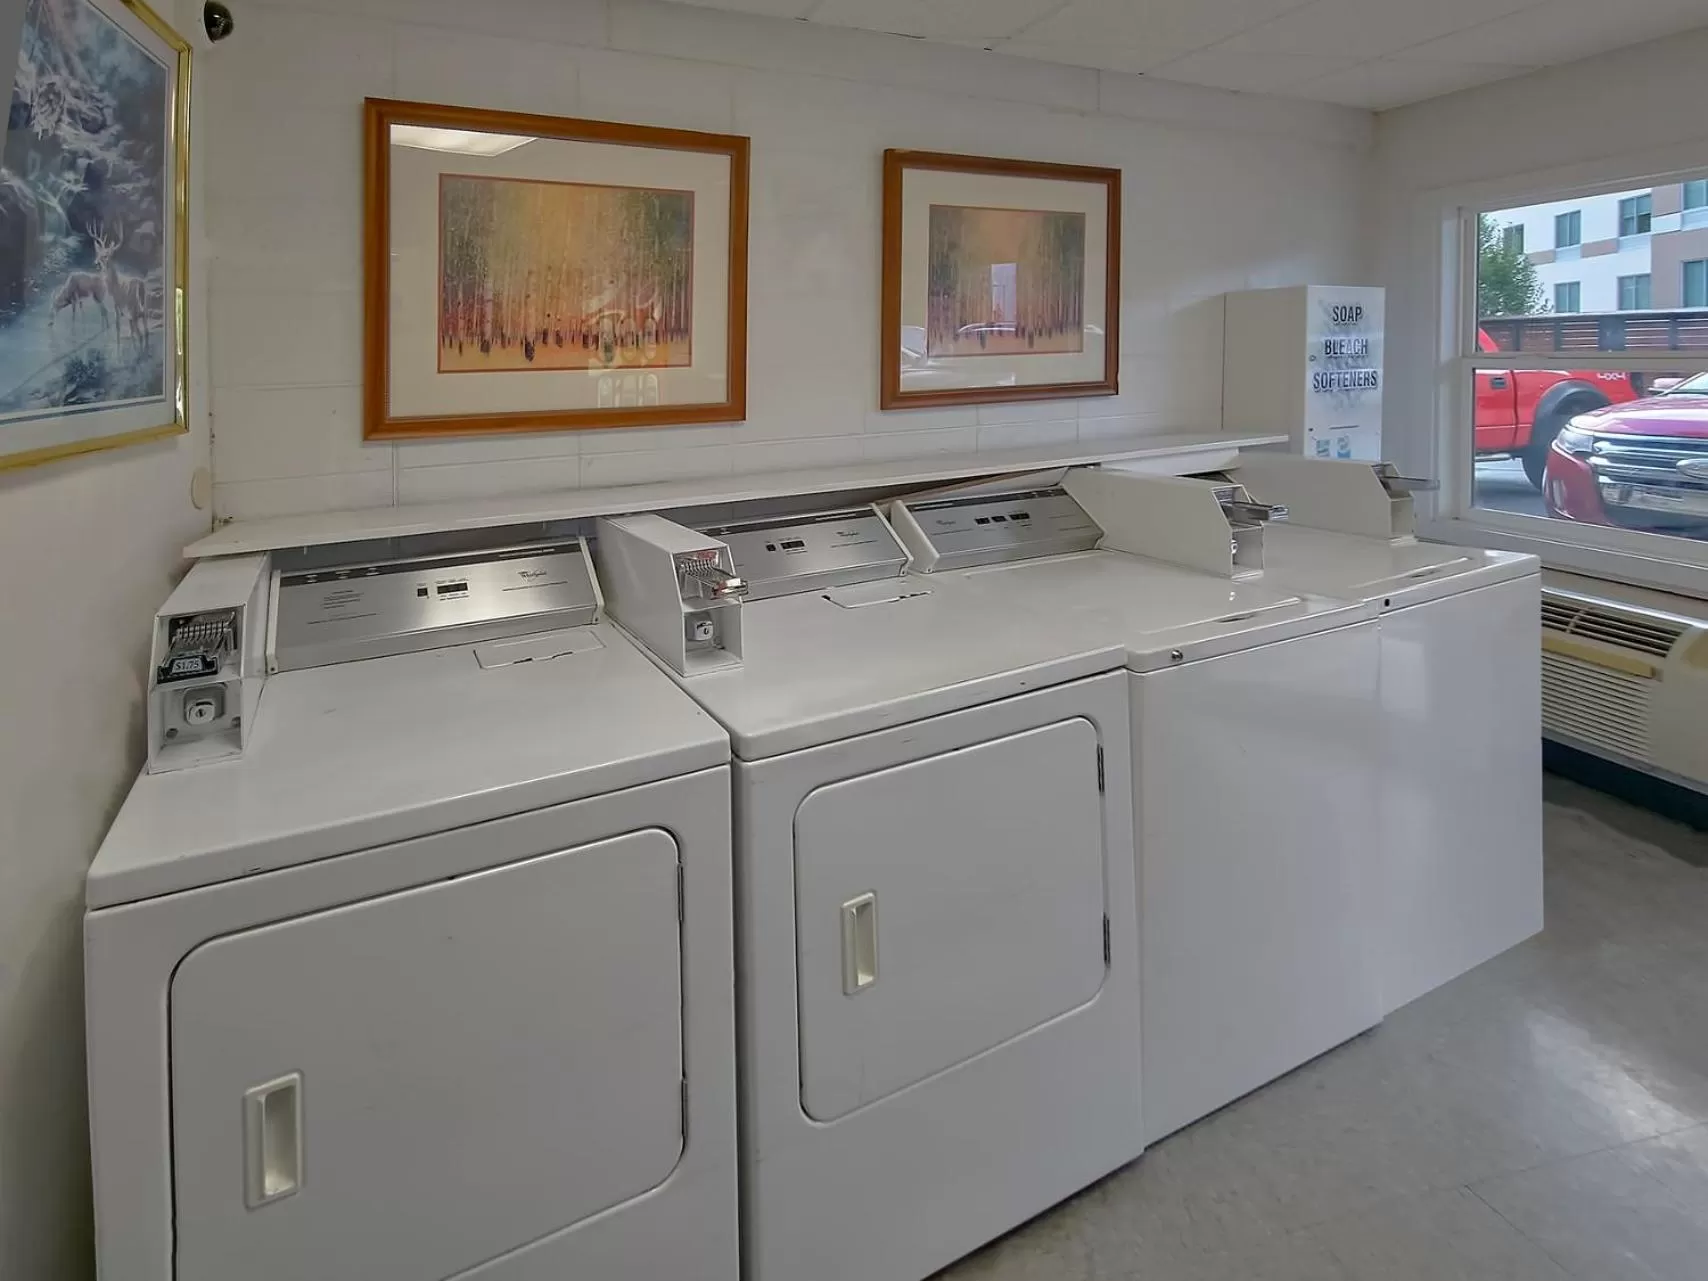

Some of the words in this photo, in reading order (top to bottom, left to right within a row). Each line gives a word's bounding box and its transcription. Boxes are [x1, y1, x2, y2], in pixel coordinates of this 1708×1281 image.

[1332, 305, 1363, 323] SOAP
[1324, 338, 1369, 355] BLEACH
[1313, 370, 1377, 389] SOFTENERS
